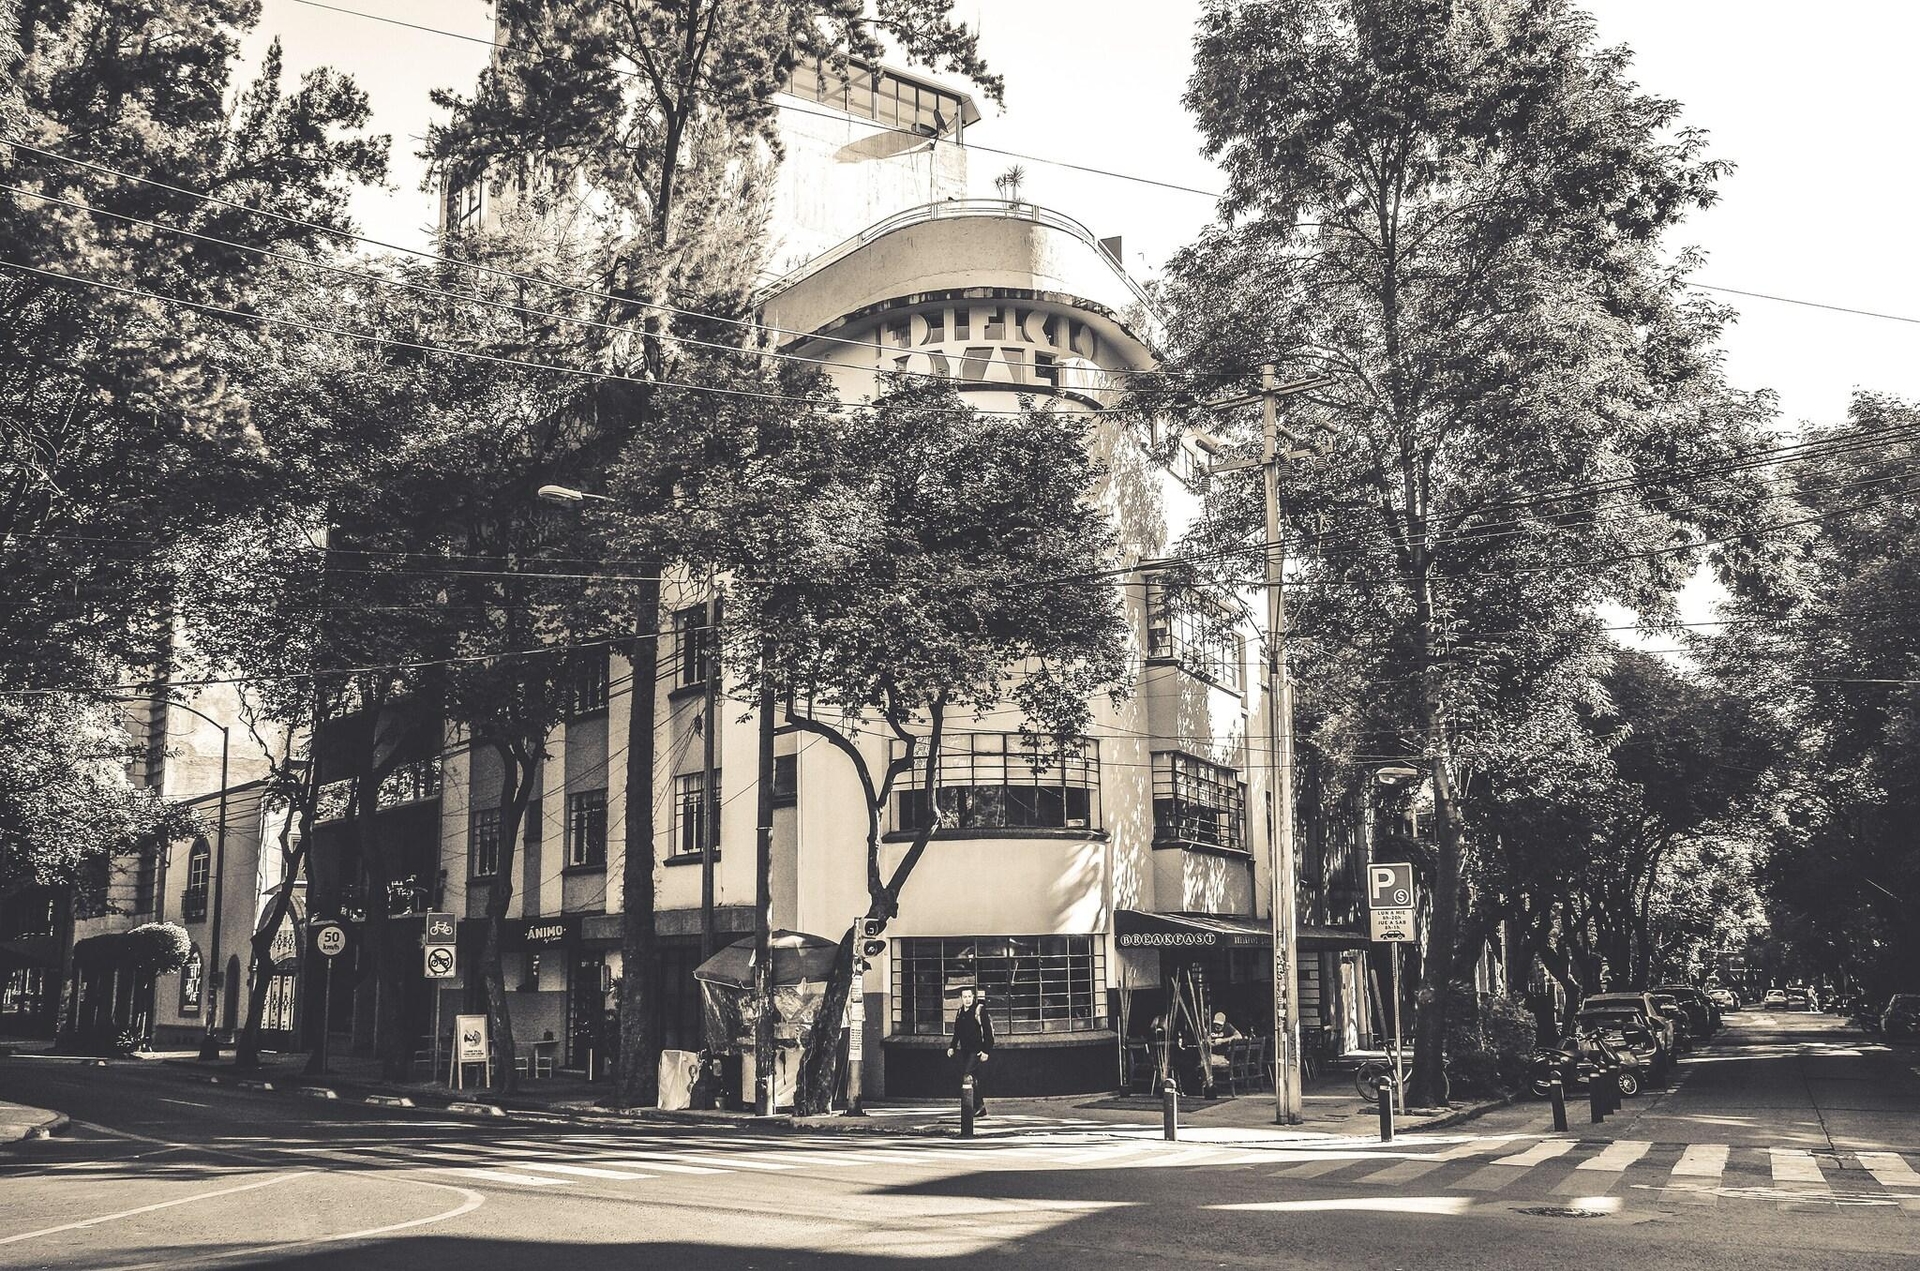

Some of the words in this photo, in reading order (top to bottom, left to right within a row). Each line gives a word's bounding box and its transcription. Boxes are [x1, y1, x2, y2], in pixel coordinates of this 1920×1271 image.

[1371, 868, 1396, 899] P
[324, 932, 340, 942] 50
[527, 925, 563, 940] ÁNIMO
[1121, 932, 1216, 946] BREAKFAST
